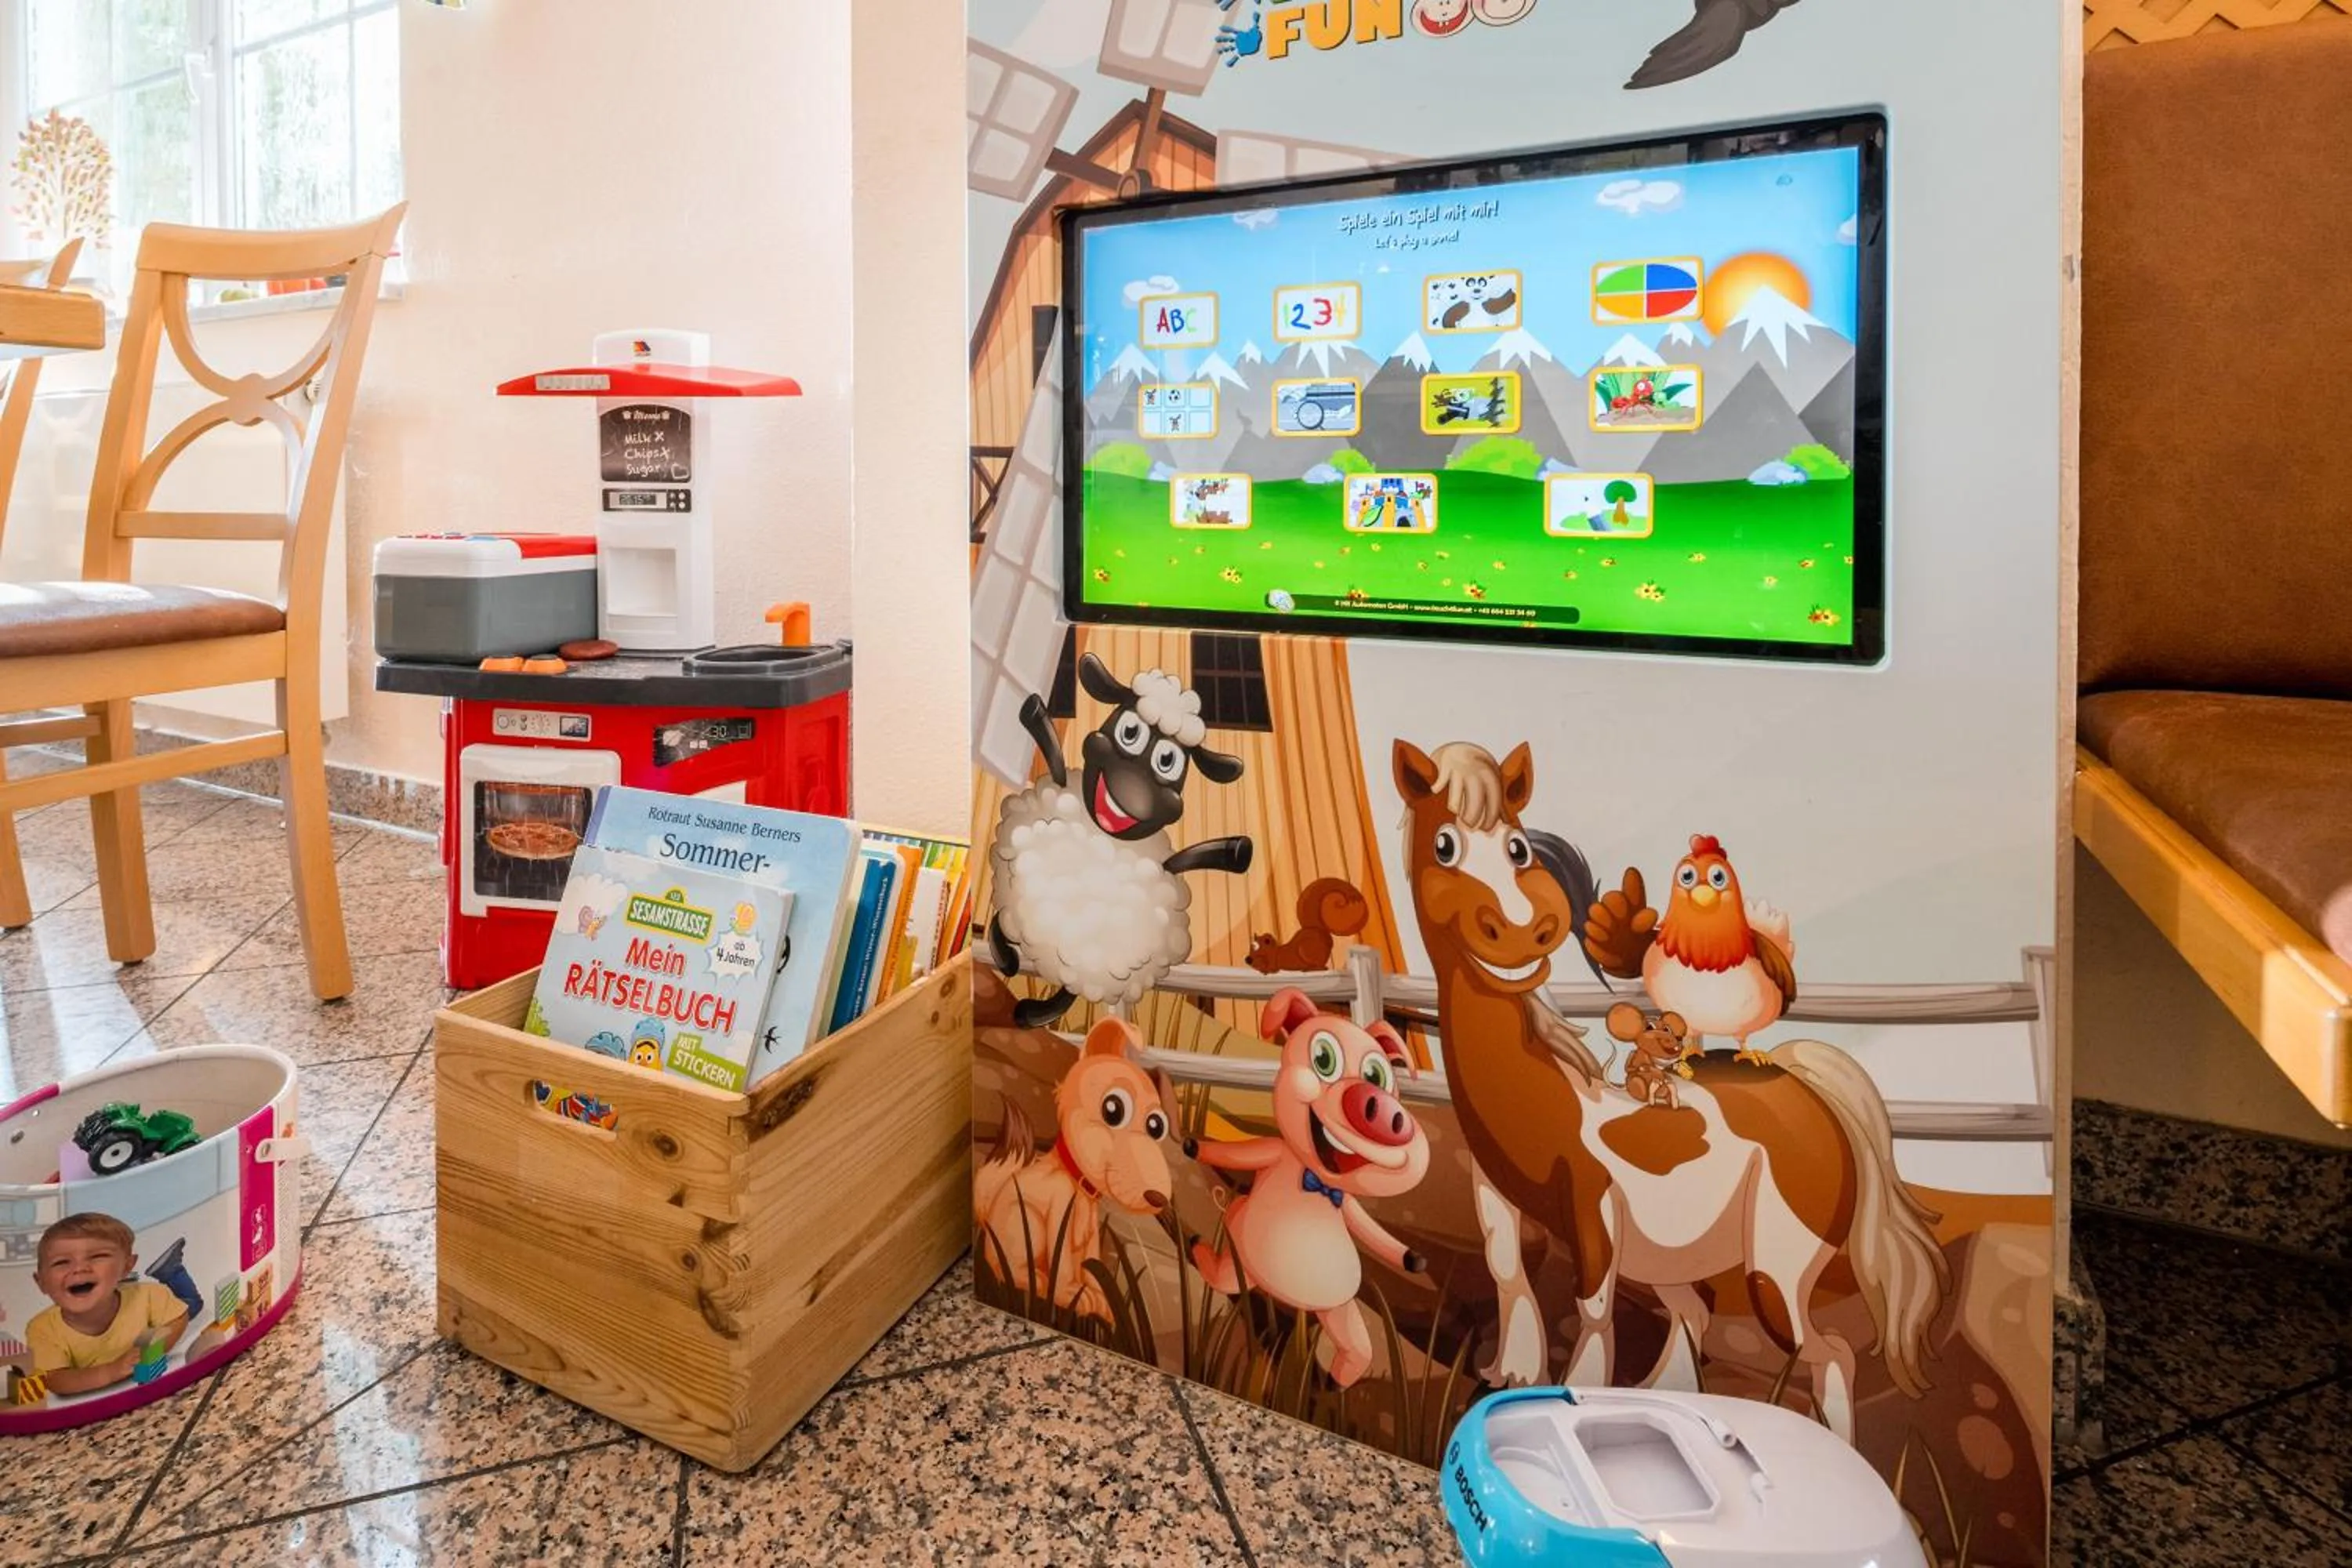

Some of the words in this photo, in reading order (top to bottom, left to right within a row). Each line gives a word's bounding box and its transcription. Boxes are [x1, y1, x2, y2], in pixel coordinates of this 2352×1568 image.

[1267, 0, 1403, 60] FUN
[1340, 212, 1377, 236] Spiele
[1381, 210, 1403, 227] ein
[1408, 205, 1440, 230] Spiel
[1444, 203, 1467, 221] mit
[1471, 200, 1499, 218] mir!
[1156, 307, 1197, 333] ABC
[627, 464, 660, 477] Sugar
[648, 807, 691, 826] Rotraut
[694, 813, 747, 835] Susanne
[750, 822, 801, 843] Berners
[659, 833, 771, 873] Sommer-
[630, 901, 709, 936] SESAMSTRASSE
[626, 937, 685, 977] Mein
[716, 947, 724, 962] 4
[723, 950, 755, 967] Jahren
[734, 942, 746, 950] ab
[564, 959, 736, 1033] RÄTSELBUCH
[677, 1036, 699, 1051] MIT
[674, 1051, 735, 1087] STICKERN
[1455, 1465, 1487, 1533] BOSCH
